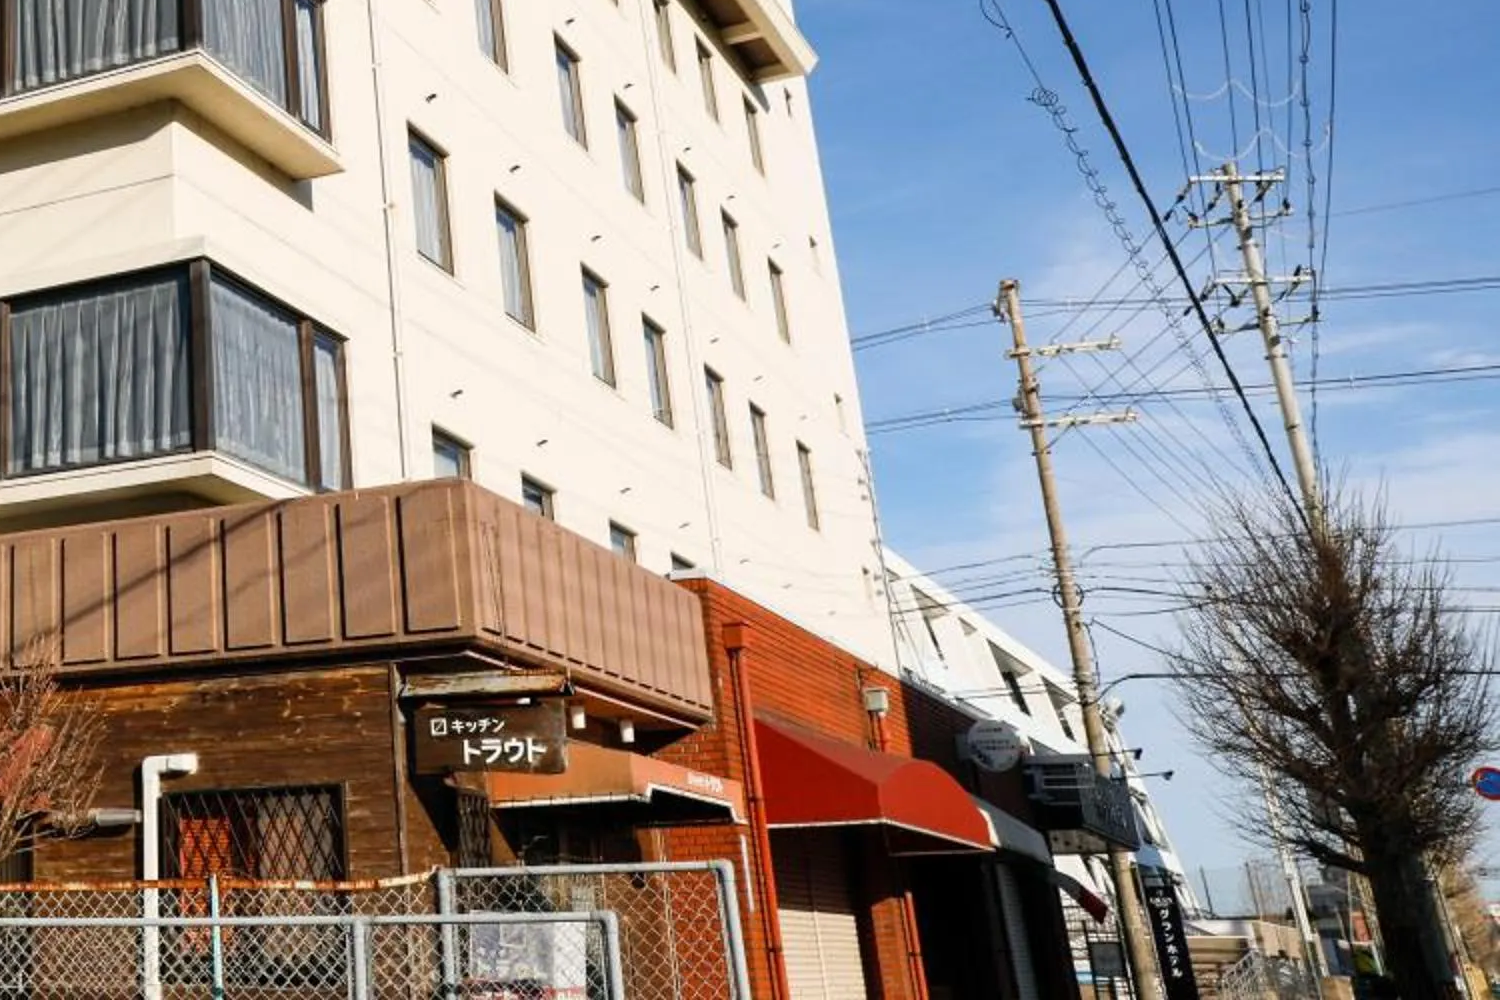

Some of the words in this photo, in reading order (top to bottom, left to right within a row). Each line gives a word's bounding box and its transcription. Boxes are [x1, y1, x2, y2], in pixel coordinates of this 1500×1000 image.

[451, 718, 505, 733] キッチン
[463, 738, 548, 765] トラウト
